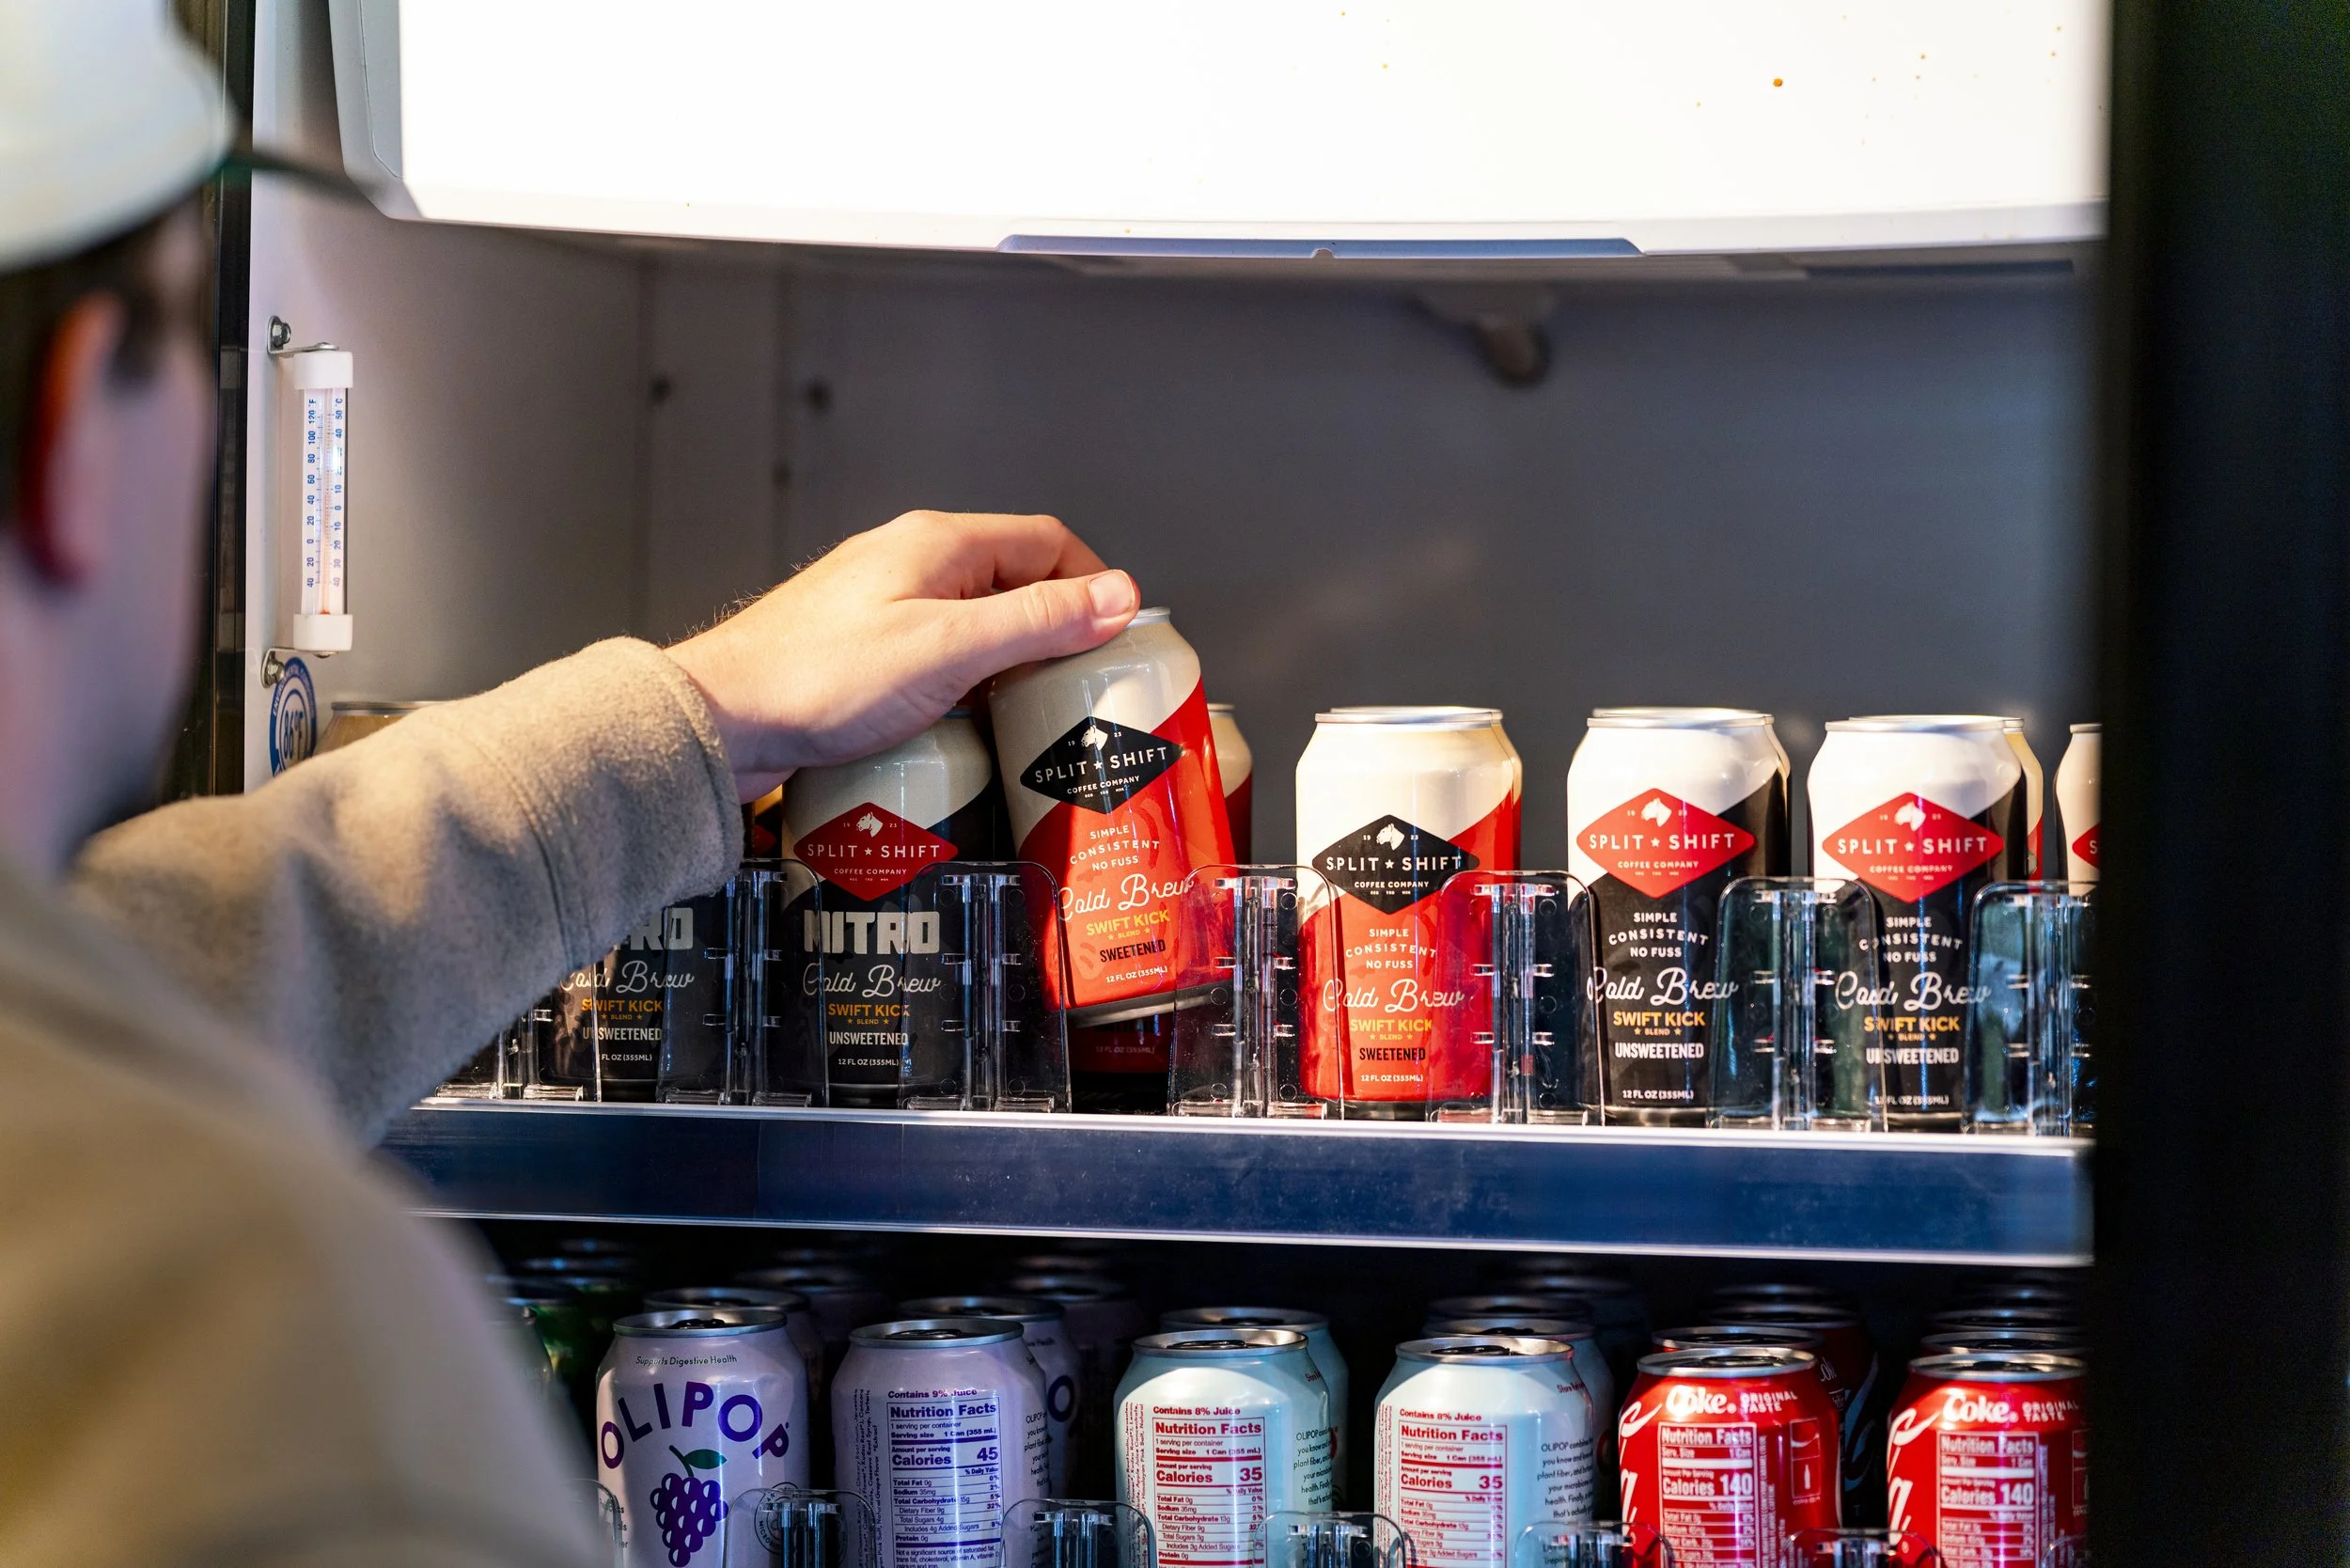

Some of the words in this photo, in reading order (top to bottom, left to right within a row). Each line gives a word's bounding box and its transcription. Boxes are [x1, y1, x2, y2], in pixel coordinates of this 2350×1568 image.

[335, 410, 342, 420] 50
[335, 429, 342, 439] 40
[307, 453, 316, 463] 80
[307, 474, 315, 484] 60
[335, 484, 342, 494] 10
[307, 494, 315, 505] 40
[306, 515, 315, 525] 20
[334, 522, 341, 530] 10
[334, 540, 341, 550] 20
[306, 557, 314, 567] 20
[306, 577, 314, 588] 40
[1035, 760, 1088, 783] SPLIT
[1109, 746, 1167, 769] SHIFT
[1067, 783, 1098, 794] COFFEE
[1100, 776, 1140, 789] COMPANY
[1089, 825, 1130, 839] SIMPLE
[1589, 834, 1644, 850] SPLIT
[1668, 833, 1735, 850] SHIFT
[1837, 838, 1898, 855] SPLIT
[1922, 837, 1987, 855] SHIFT
[807, 843, 858, 857] SPLIT
[881, 845, 940, 858] SHIFT
[1070, 839, 1160, 865] CONSISTENT
[1091, 861, 1108, 870] NO
[1111, 855, 1139, 868] FUSS
[1325, 856, 1379, 871] SPLIT
[1402, 856, 1462, 871] SHIFT
[1617, 860, 1651, 869] COFFEE
[1653, 860, 1699, 869] COMPANY
[1869, 865, 1904, 873] COFFEE
[1907, 864, 1953, 873] COMPANY
[1057, 886, 1110, 921] Cold
[1118, 873, 1195, 910] Brew
[1086, 916, 1130, 936] SWIFT
[1134, 909, 1170, 928] KICK
[1633, 912, 1678, 923] SIMPLE
[1886, 917, 1933, 928] SIMPLE
[804, 910, 940, 955] NITRO
[1118, 930, 1141, 939] BLEND
[1369, 929, 1409, 937] SIMPLE
[1608, 928, 1709, 946] CONSISTENT
[1099, 939, 1167, 963] SWEETENED
[1345, 943, 1436, 958] CONSISTENT
[1630, 947, 1648, 958] NO
[1651, 947, 1683, 958] FUSS
[1366, 960, 1382, 969] NO
[1385, 960, 1414, 969] FUSS
[803, 963, 856, 996] Cold
[862, 964, 942, 998] Brew
[1105, 975, 1116, 983] 12
[1126, 971, 1137, 980] OZ
[1138, 965, 1168, 978] (355ML)
[1586, 966, 1645, 1004] Cold
[1650, 966, 1739, 1007] Brew
[1323, 978, 1379, 1012] Cold
[1385, 978, 1465, 1013] Brew
[581, 998, 625, 1012] SWIFT
[628, 999, 664, 1012] KICK
[827, 1003, 871, 1016] SWIFT
[874, 1004, 911, 1016] KICK
[1350, 1019, 1395, 1031] SWIFT
[1398, 1019, 1433, 1031] KICK
[1612, 1011, 1662, 1027] SWIFT
[1665, 1011, 1706, 1027] KICK
[1919, 1016, 1961, 1032] KICK
[829, 1031, 909, 1045] UNSWEETENED
[1359, 1047, 1426, 1061] SWEETENED
[1615, 1043, 1704, 1058] UNSWEETENED
[1622, 1090, 1633, 1099] 12
[1633, 1090, 1643, 1099] FL
[1644, 1090, 1658, 1099] OZ
[635, 1356, 668, 1367] Supports
[669, 1356, 708, 1368] Digestive
[710, 1355, 737, 1364] Health
[887, 1390, 930, 1399] Contains
[932, 1389, 948, 1398] 9%
[890, 1406, 953, 1419] Nutrition
[958, 1403, 996, 1416] Facts
[1152, 1406, 1192, 1415] Contains
[2022, 1401, 2078, 1413] ORIGINAL
[1400, 1408, 1434, 1419] Contains
[1454, 1413, 1481, 1421] Juice
[2024, 1411, 2065, 1422] TASTE
[602, 1381, 790, 1469] OLIPOP
[1155, 1422, 1216, 1435] Nutrition
[1220, 1423, 1261, 1435] Facts
[1295, 1429, 1318, 1441] OLIPOP
[1401, 1425, 1457, 1440] Nutrition
[1462, 1429, 1503, 1441] Facts
[1662, 1427, 1713, 1445] Nutrition
[1716, 1428, 1752, 1445] Facts
[1940, 1436, 1996, 1453] Nutrition
[1999, 1437, 2034, 1453] Facts
[892, 1454, 952, 1466] Calories
[977, 1447, 999, 1462] 45
[1156, 1470, 1213, 1482] Calories
[1239, 1466, 1262, 1482] 35
[1401, 1473, 1452, 1488] Calories
[1479, 1475, 1503, 1490] 35
[1663, 1476, 1716, 1496] Calories
[1719, 1472, 1753, 1497] 140
[1941, 1485, 1996, 1505] Calories
[1999, 1482, 2034, 1505] 140
